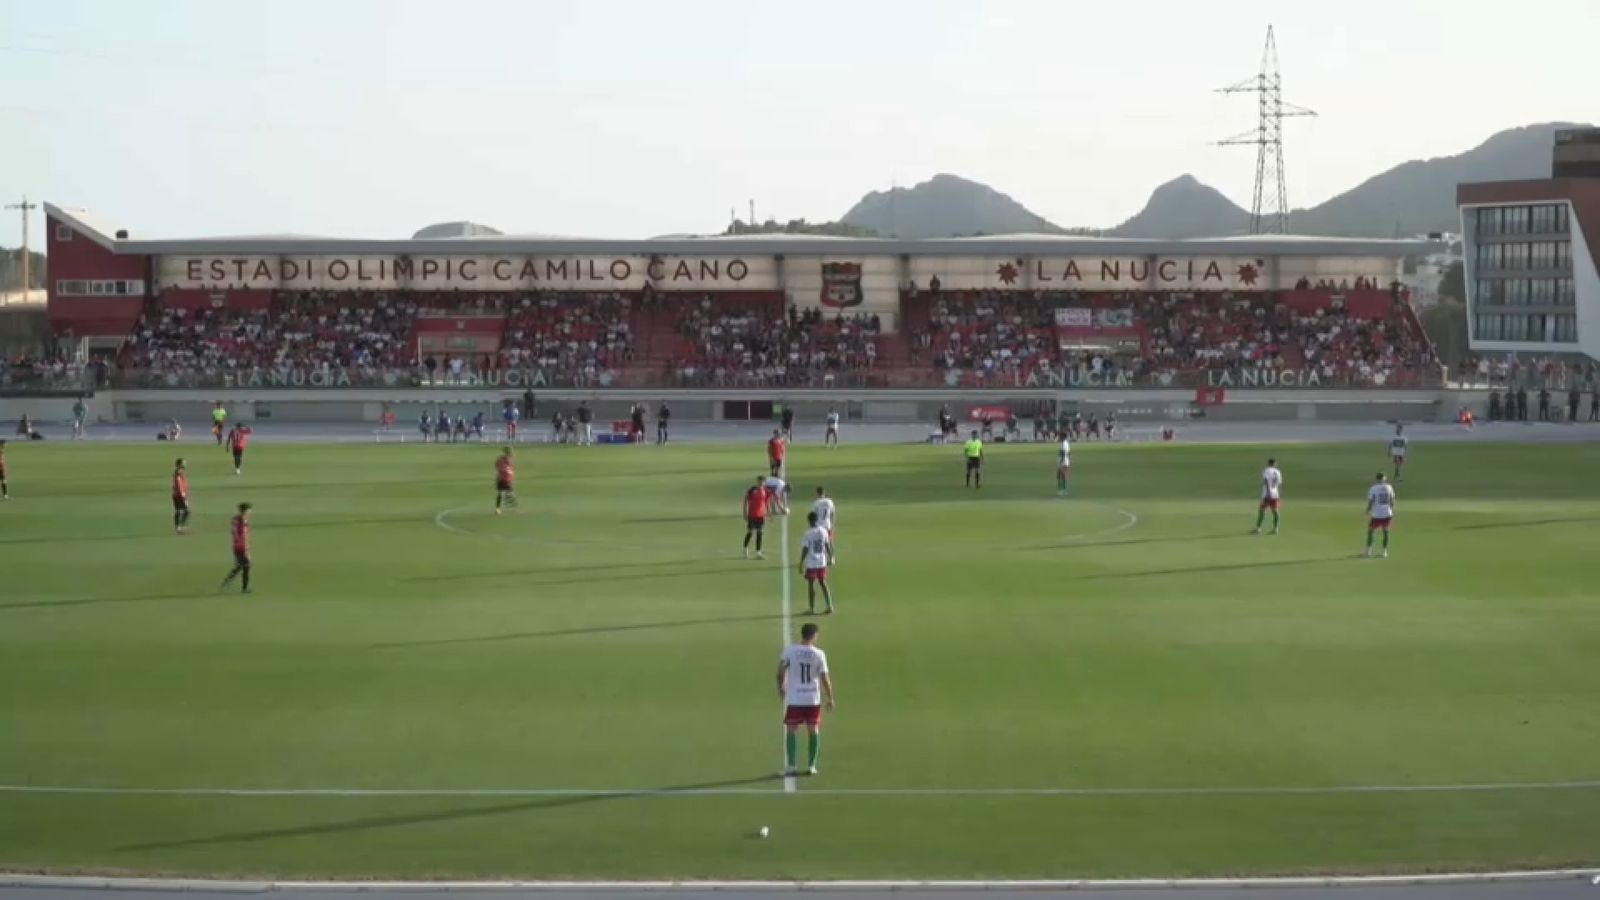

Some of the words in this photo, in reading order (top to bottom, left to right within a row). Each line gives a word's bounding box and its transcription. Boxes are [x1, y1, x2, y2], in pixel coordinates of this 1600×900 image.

[186, 259, 313, 281] ESTADI
[327, 259, 478, 281] OLIMPIC
[493, 259, 632, 281] CAMILO
[646, 259, 749, 281] CANO
[1037, 260, 1082, 281] LA
[1100, 260, 1223, 281] NUCIA
[1014, 368, 1039, 386] LA
[1207, 369, 1234, 386] LA
[799, 662, 811, 684] 11
